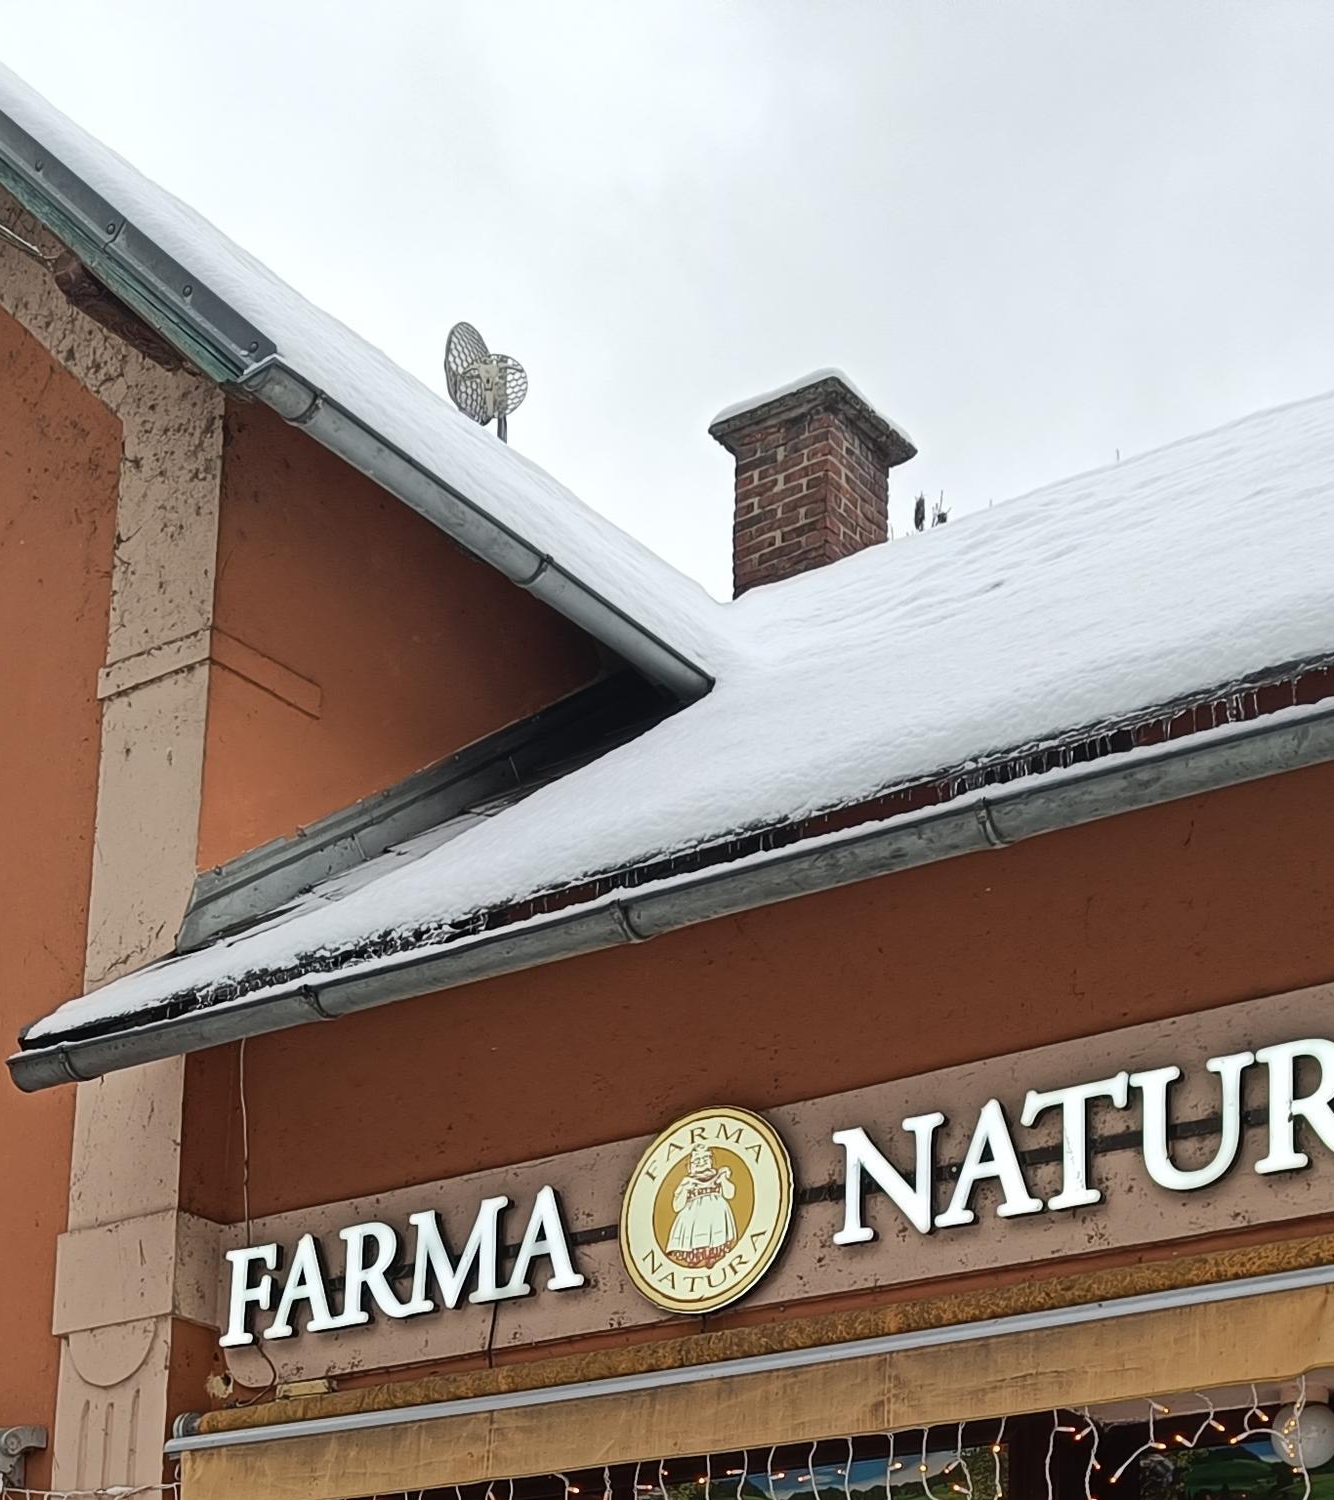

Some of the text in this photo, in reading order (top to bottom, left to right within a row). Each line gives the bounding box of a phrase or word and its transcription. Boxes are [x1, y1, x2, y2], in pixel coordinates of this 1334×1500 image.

[645, 1123, 764, 1182] FARMA
[219, 1185, 585, 1348] FARMA
[643, 1230, 767, 1292] NATURA
